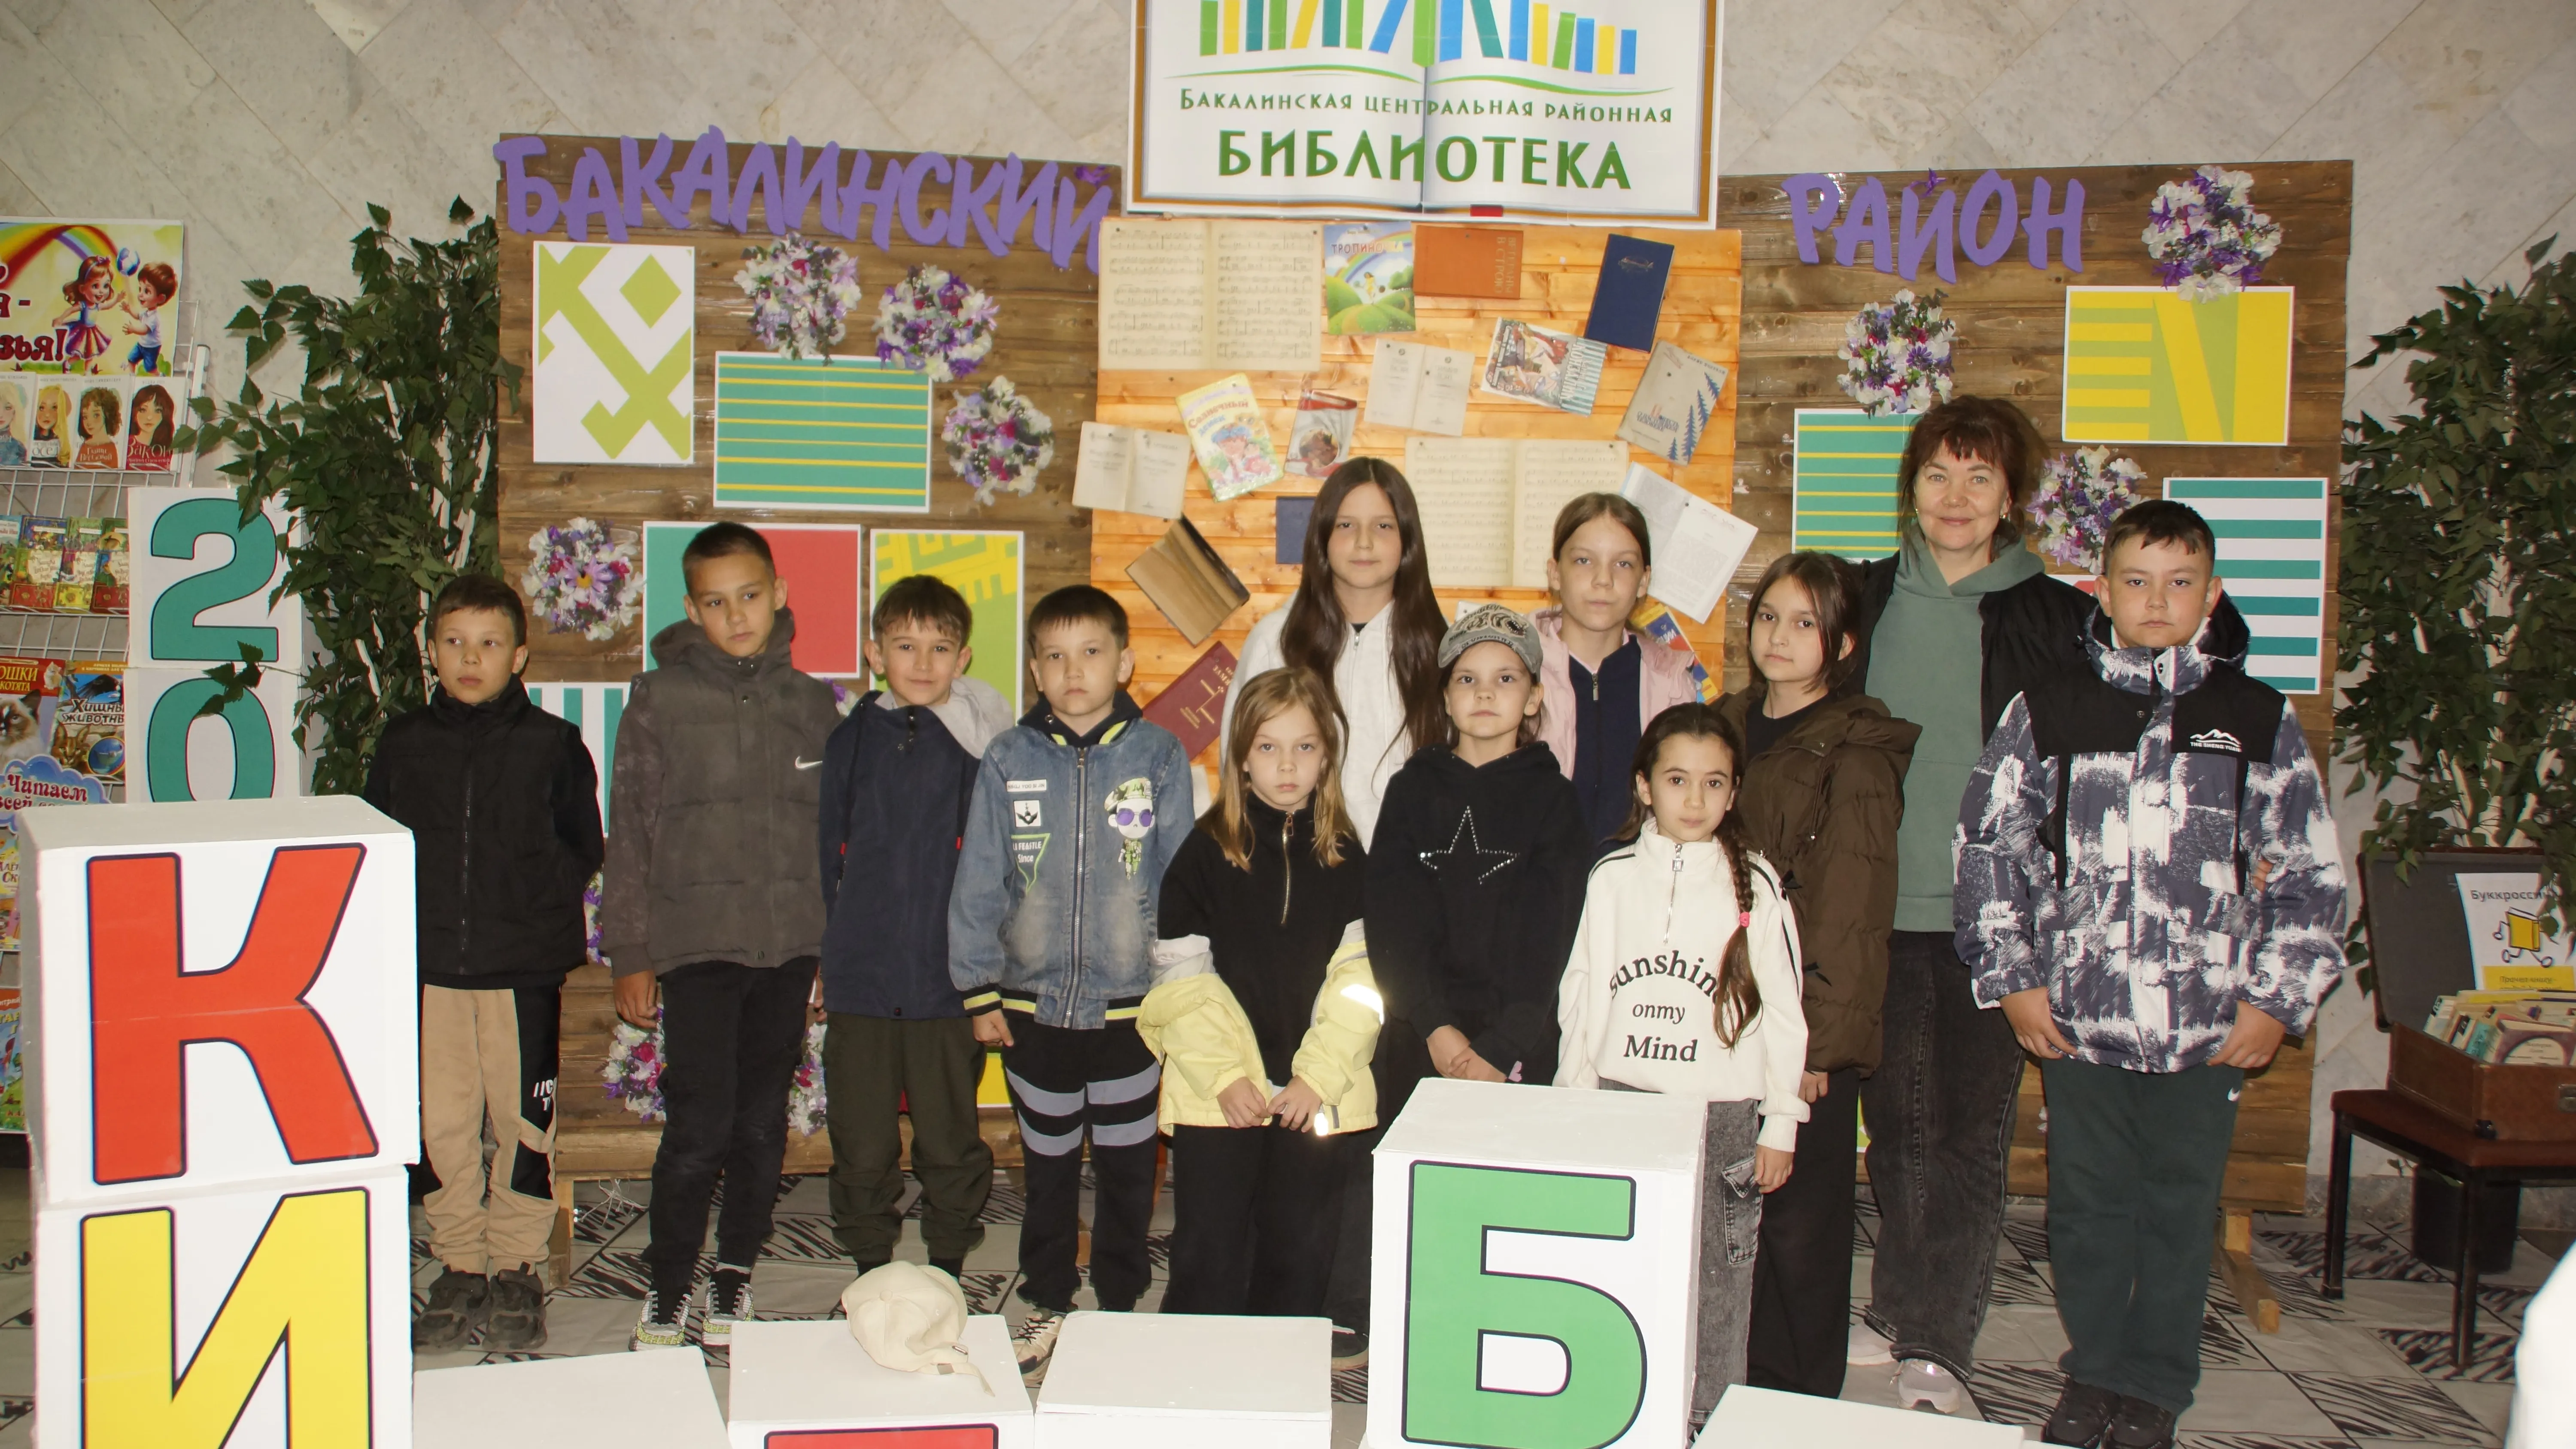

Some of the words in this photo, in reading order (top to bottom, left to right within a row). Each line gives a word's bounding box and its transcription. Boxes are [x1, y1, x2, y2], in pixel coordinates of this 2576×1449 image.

[1218, 129, 1632, 190] БИБЛИОТЕКА
[151, 498, 279, 661] 2
[8, 774, 87, 802] Читаем
[1018, 854, 1034, 863] Since
[86, 843, 379, 1185] К
[1632, 1004, 1685, 1025] onmy
[1623, 1034, 1698, 1062] Mind
[80, 1186, 371, 1449] И
[1401, 1160, 1647, 1449] Б
